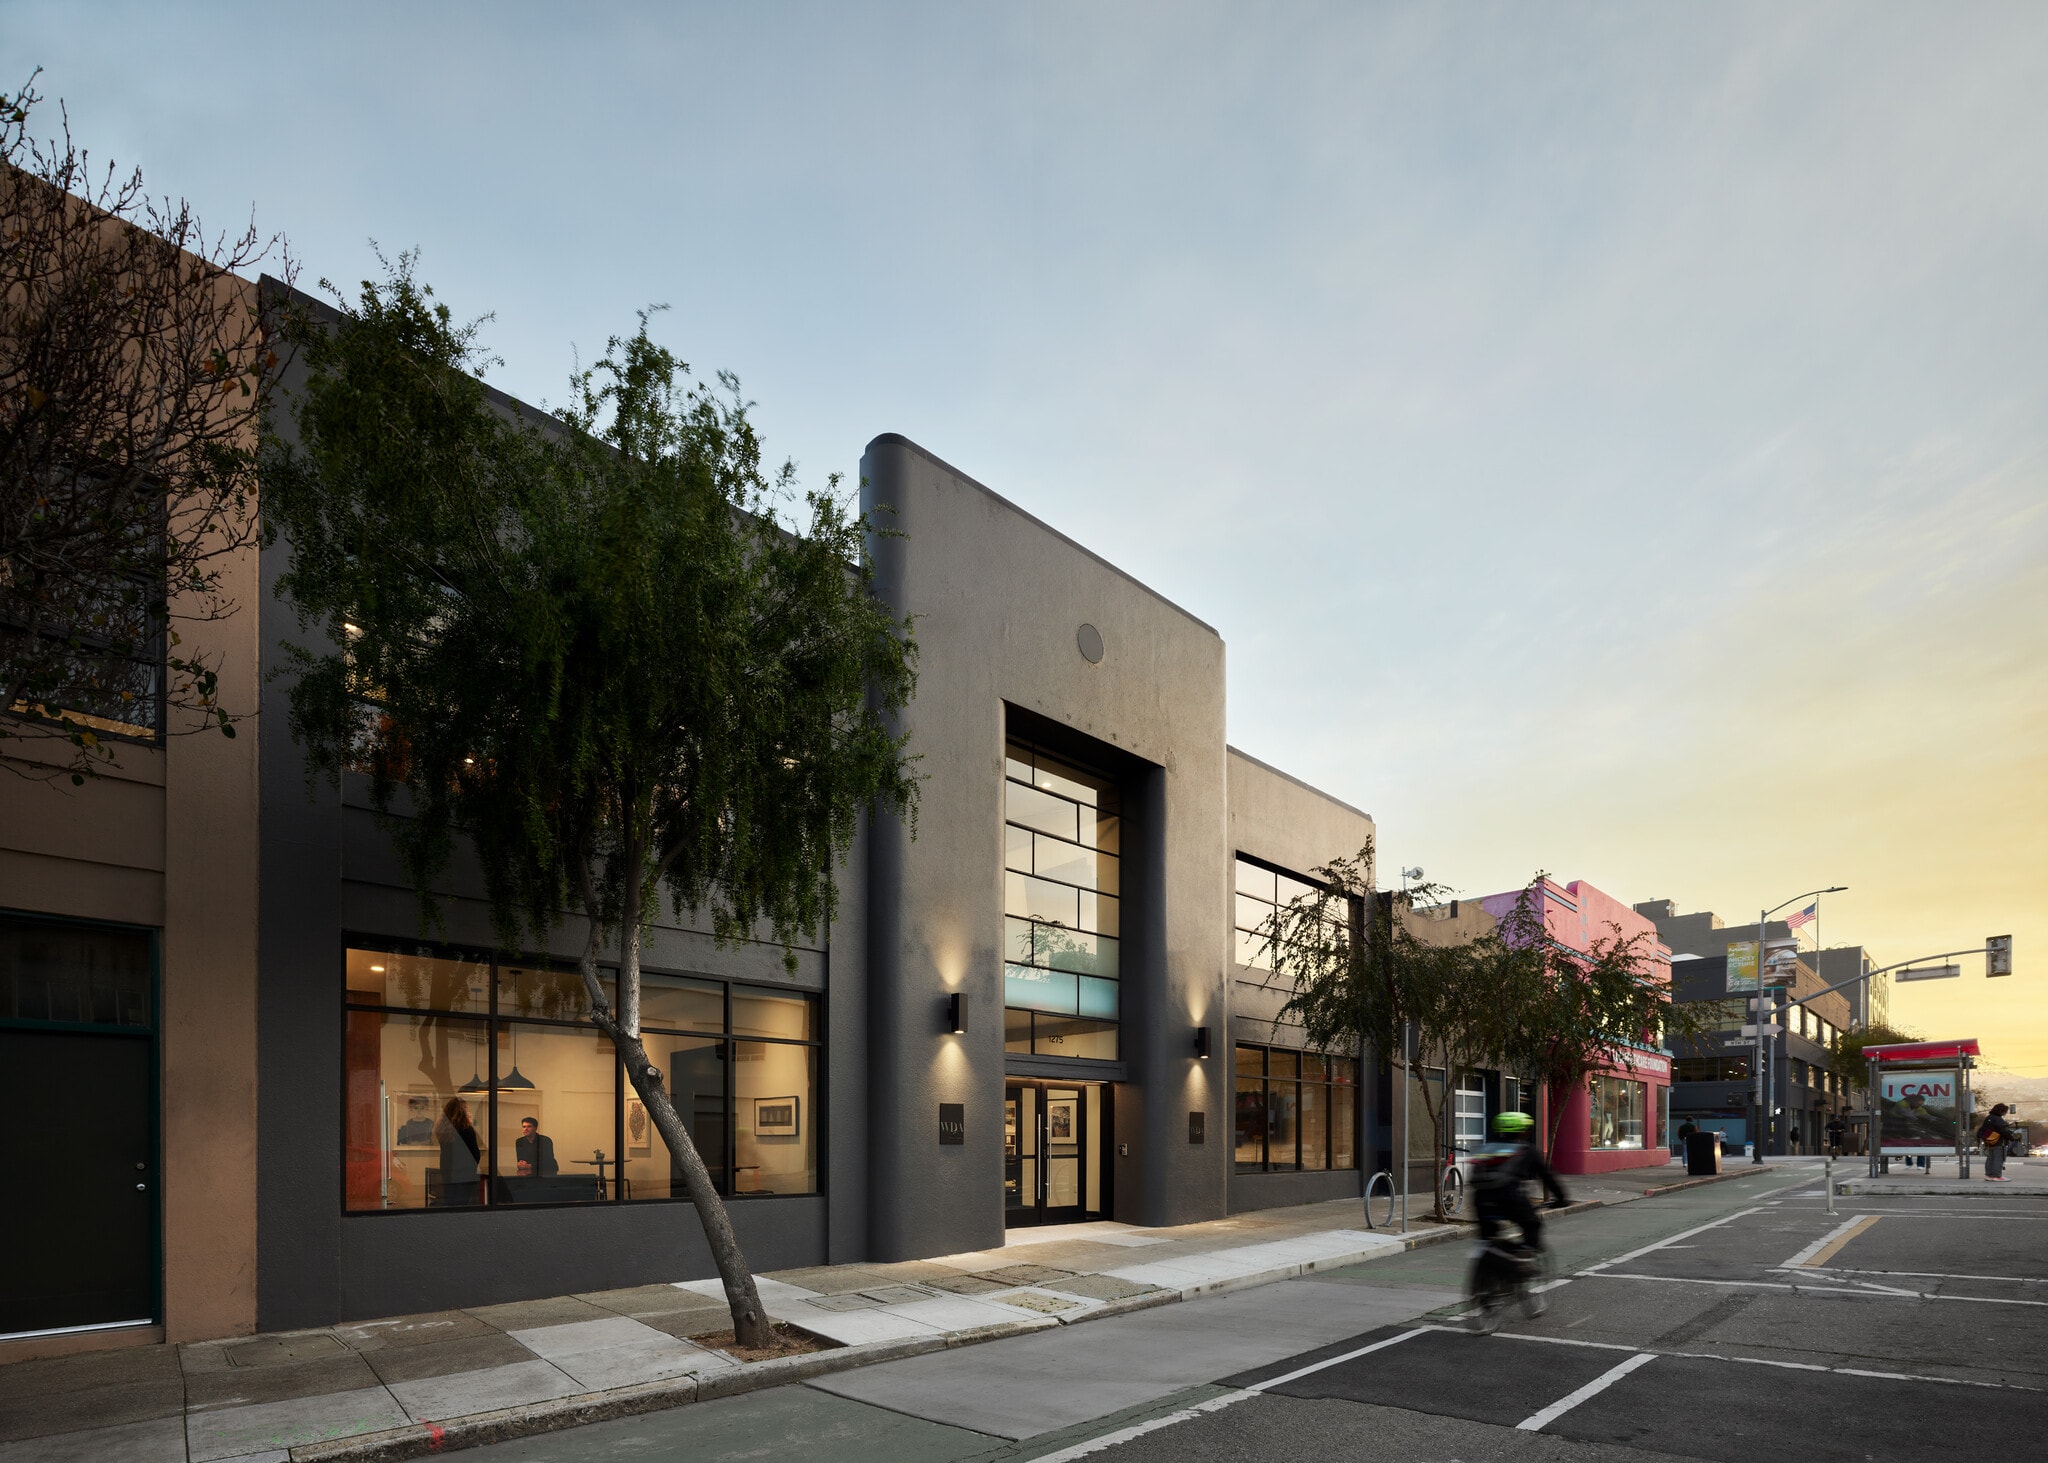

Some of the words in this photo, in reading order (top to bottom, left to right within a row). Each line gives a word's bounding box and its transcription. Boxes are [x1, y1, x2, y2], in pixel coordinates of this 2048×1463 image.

[1048, 1035, 1064, 1044] 1275
[1888, 1084, 1894, 1098] I
[1900, 1083, 1950, 1098] CAN
